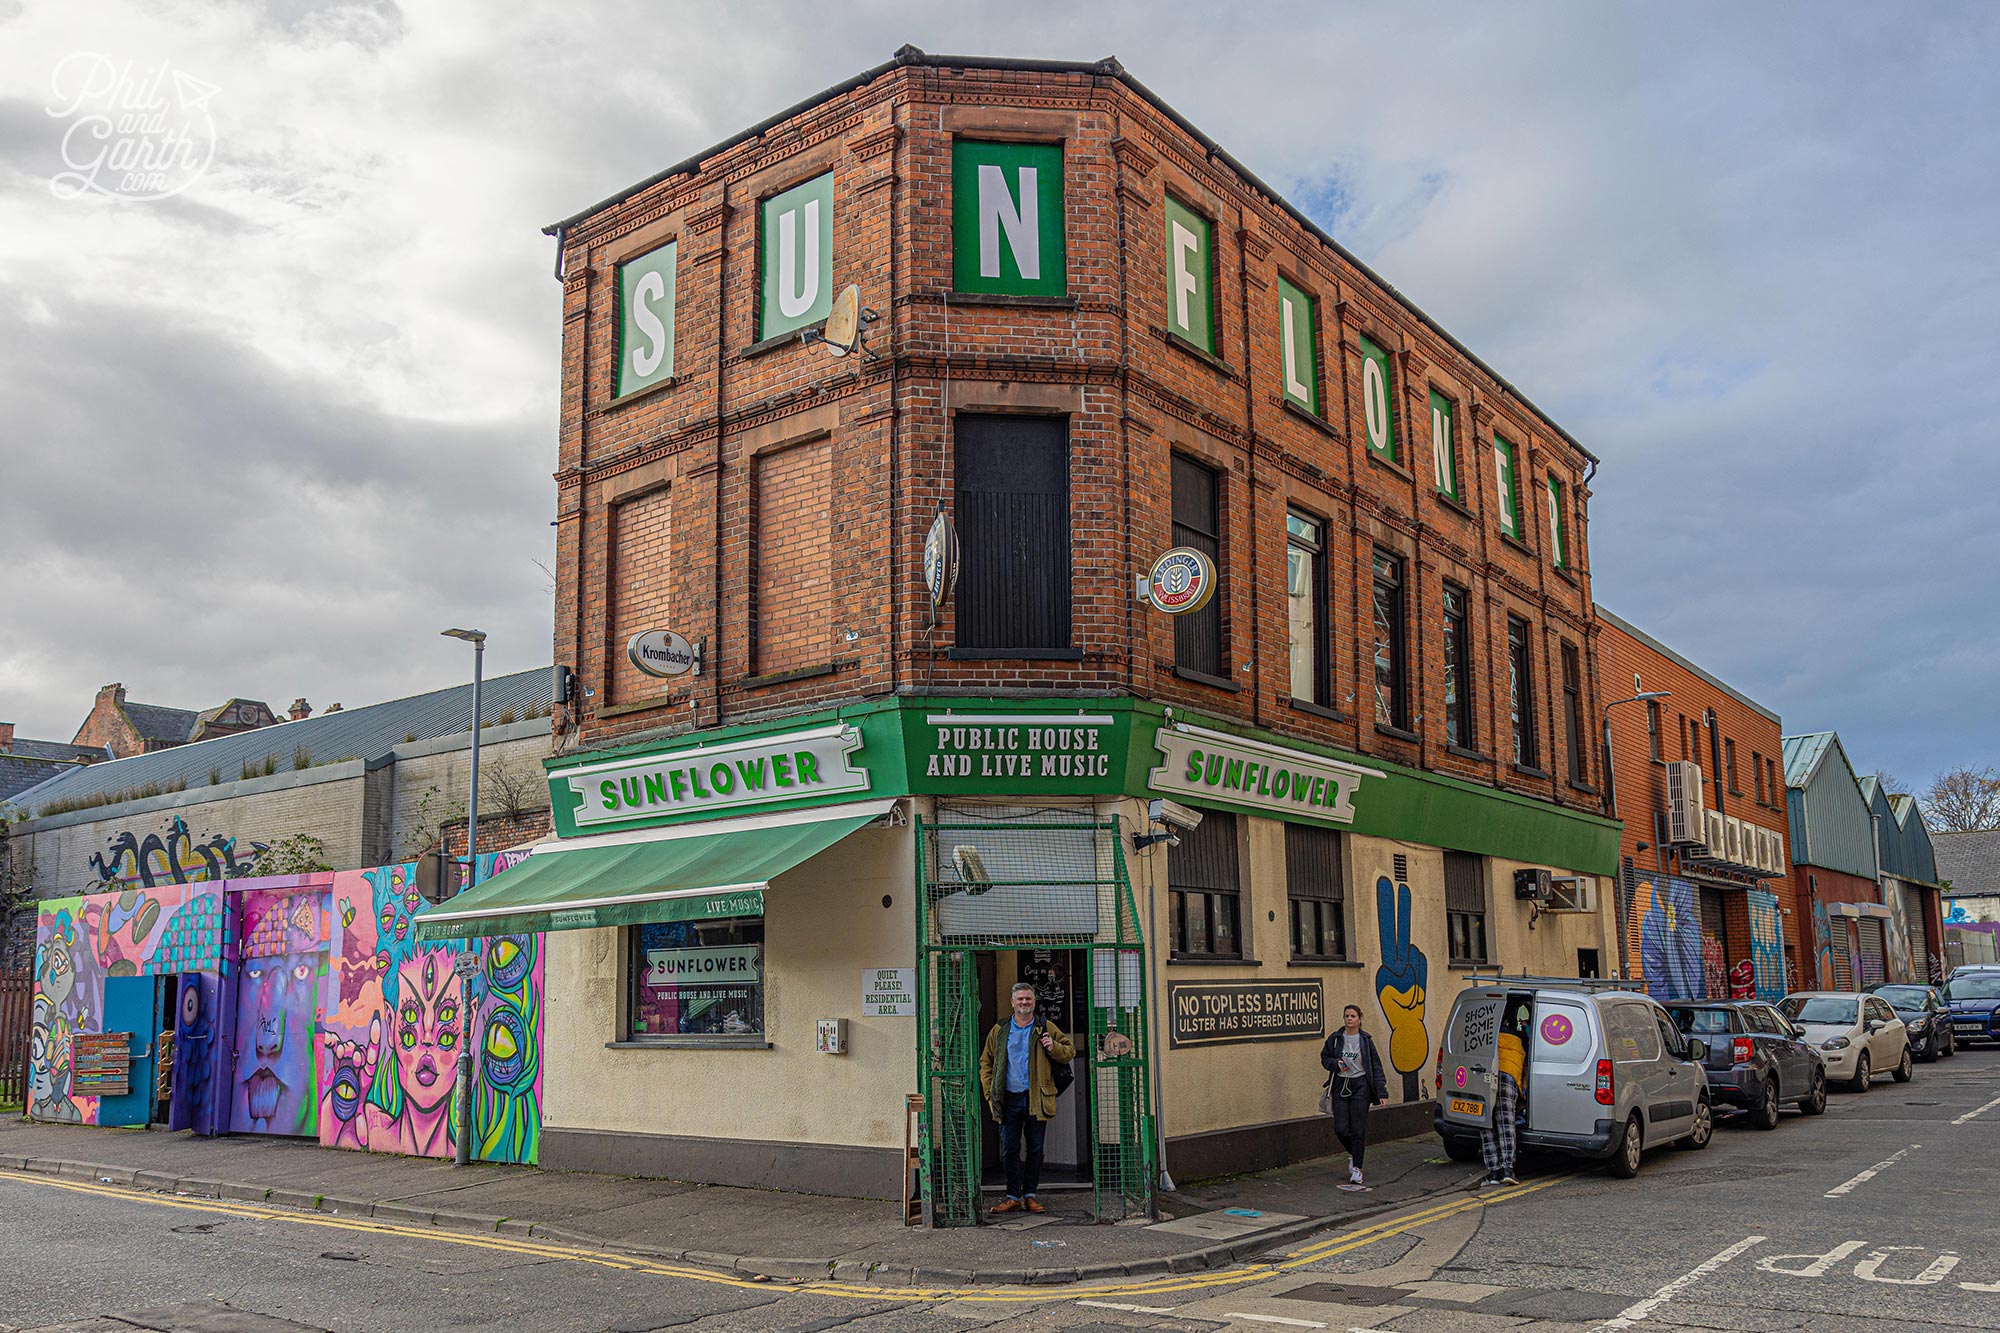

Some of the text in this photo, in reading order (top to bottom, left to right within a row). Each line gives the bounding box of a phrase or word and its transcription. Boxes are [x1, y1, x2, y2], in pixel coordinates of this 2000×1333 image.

[633, 271, 664, 377] S
[779, 199, 819, 318] U
[978, 165, 1040, 280] N
[1172, 219, 1197, 331] F
[1282, 297, 1308, 403] L
[1363, 357, 1388, 450] O
[1155, 555, 1199, 578] ERDINGER
[643, 644, 690, 666] Krombacher
[937, 728, 1099, 750] PUBLIC HOUSE
[926, 754, 1108, 777] AND LIVE MUSIC
[600, 751, 820, 811] SUNFLOWER
[1185, 749, 1340, 809] SUNFLOWER
[706, 898, 760, 913] LIVE MUSIC
[555, 913, 593, 924] SUNFLOWER
[657, 957, 747, 975] SUNFLOWER
[877, 970, 898, 980] QUIET
[657, 989, 748, 1000] PUBLIC HOUSE AND LIVE MUSIC
[874, 981, 903, 991] PLEASE!
[865, 993, 912, 1004] RESIDENTIAL
[1178, 991, 1318, 1016] NO TOPLESS BATHING
[1179, 1017, 1216, 1033] ULSTER
[1219, 1016, 1239, 1030] HAS
[1285, 1012, 1319, 1026] ENOUGH
[1465, 1003, 1497, 1024] SHOW
[1711, 1013, 1723, 1026] L
[1464, 1017, 1494, 1038] SOME
[1464, 1032, 1493, 1053] LOVE
[1453, 1101, 1480, 1114] CXZ 7881
